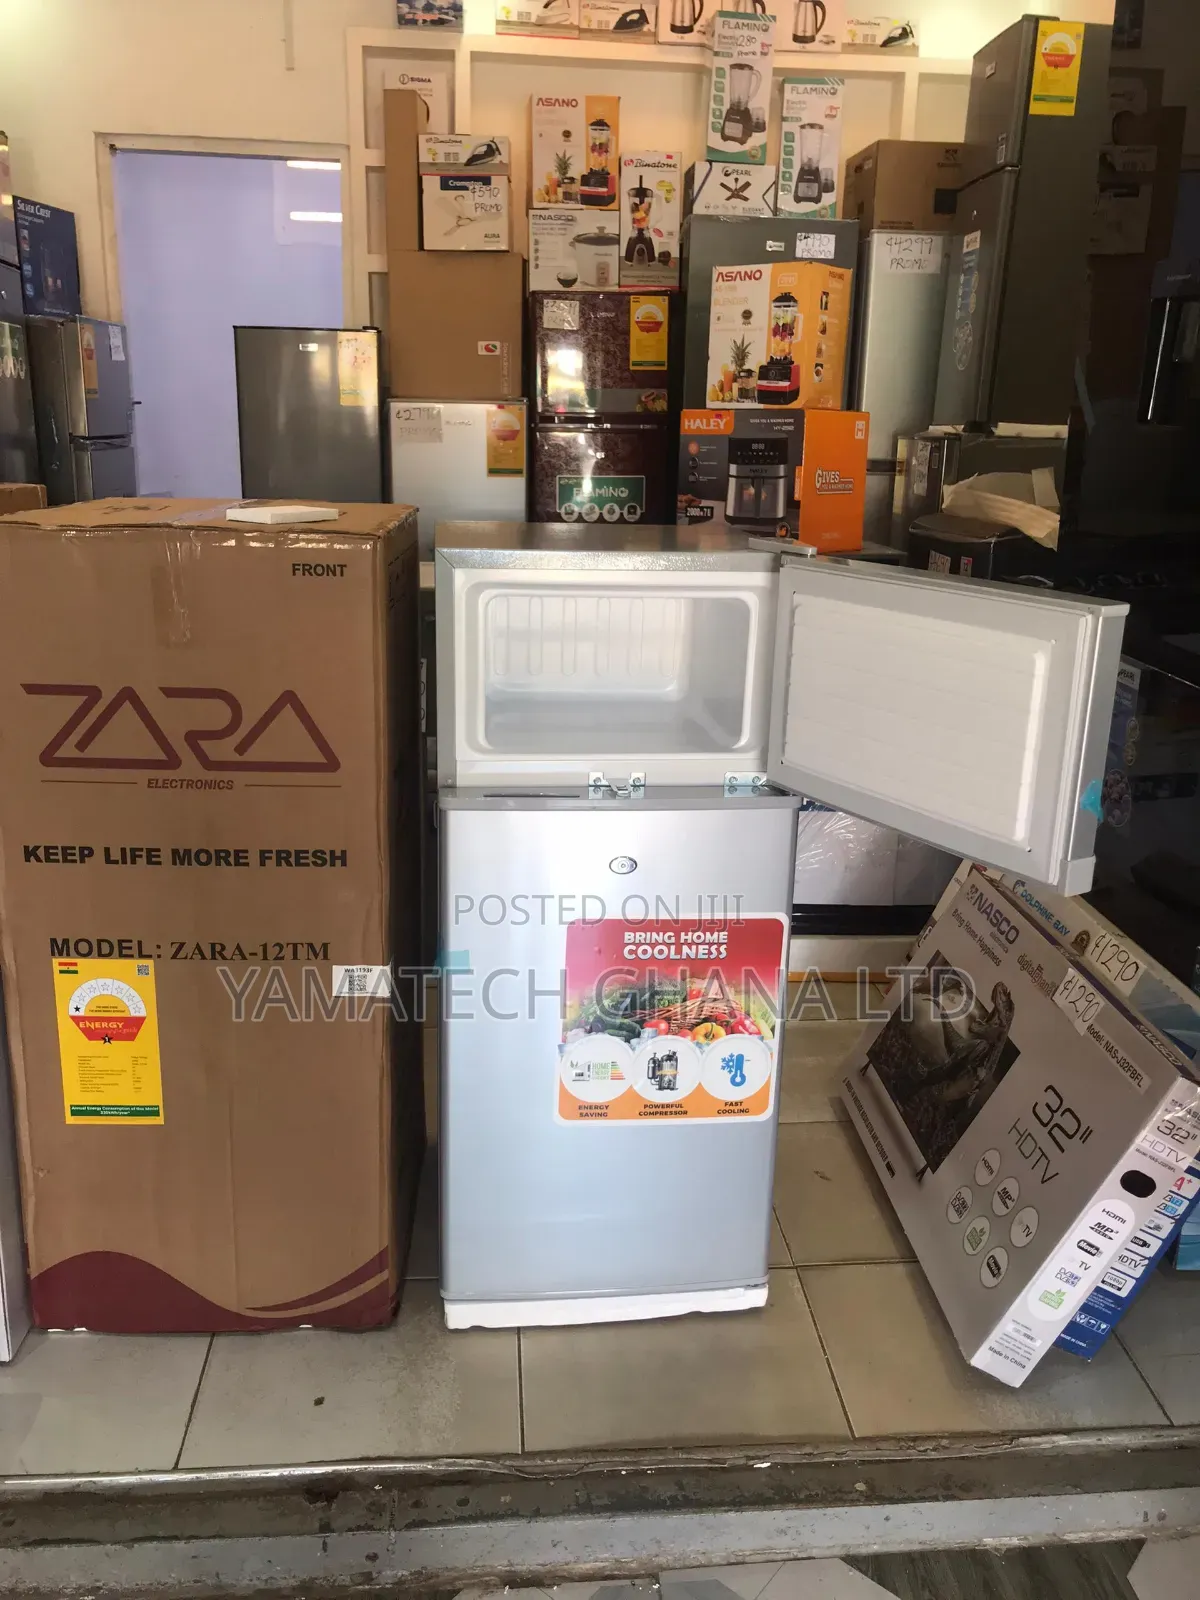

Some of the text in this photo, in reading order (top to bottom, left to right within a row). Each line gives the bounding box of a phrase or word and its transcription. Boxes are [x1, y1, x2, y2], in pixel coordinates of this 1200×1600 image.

[536, 97, 579, 108] ASANO
[634, 158, 678, 170] Binatone
[474, 203, 502, 213] PROMO
[889, 257, 930, 270] PROMO
[715, 269, 763, 283] ASANO
[684, 418, 728, 430] HALEY
[815, 467, 840, 489] GIVES
[291, 562, 347, 578] FRONT
[20, 683, 341, 773] ZARA
[146, 778, 234, 791] ELECTRONICS
[23, 845, 348, 868] KEEP LIFE MORE FRESH
[972, 891, 1020, 945] NASCO
[1020, 889, 1071, 937] DOLPHINE BAY
[623, 931, 728, 944] BRING HOME
[951, 908, 1002, 967] Bring Home Happiness
[49, 937, 331, 961] MODEL: ZARA-12TM
[623, 944, 728, 960] COOLNESS
[79, 1020, 124, 1030] ENERGY
[1103, 1040, 1144, 1088] NAS-J32FBFL
[1007, 1117, 1060, 1185] HDTV
[1141, 1134, 1187, 1163] HDTV
[1022, 1224, 1033, 1238] TV
[1078, 1240, 1098, 1256] Movie
[1079, 1260, 1091, 1271] TV
[987, 1345, 1026, 1370] Made in China
